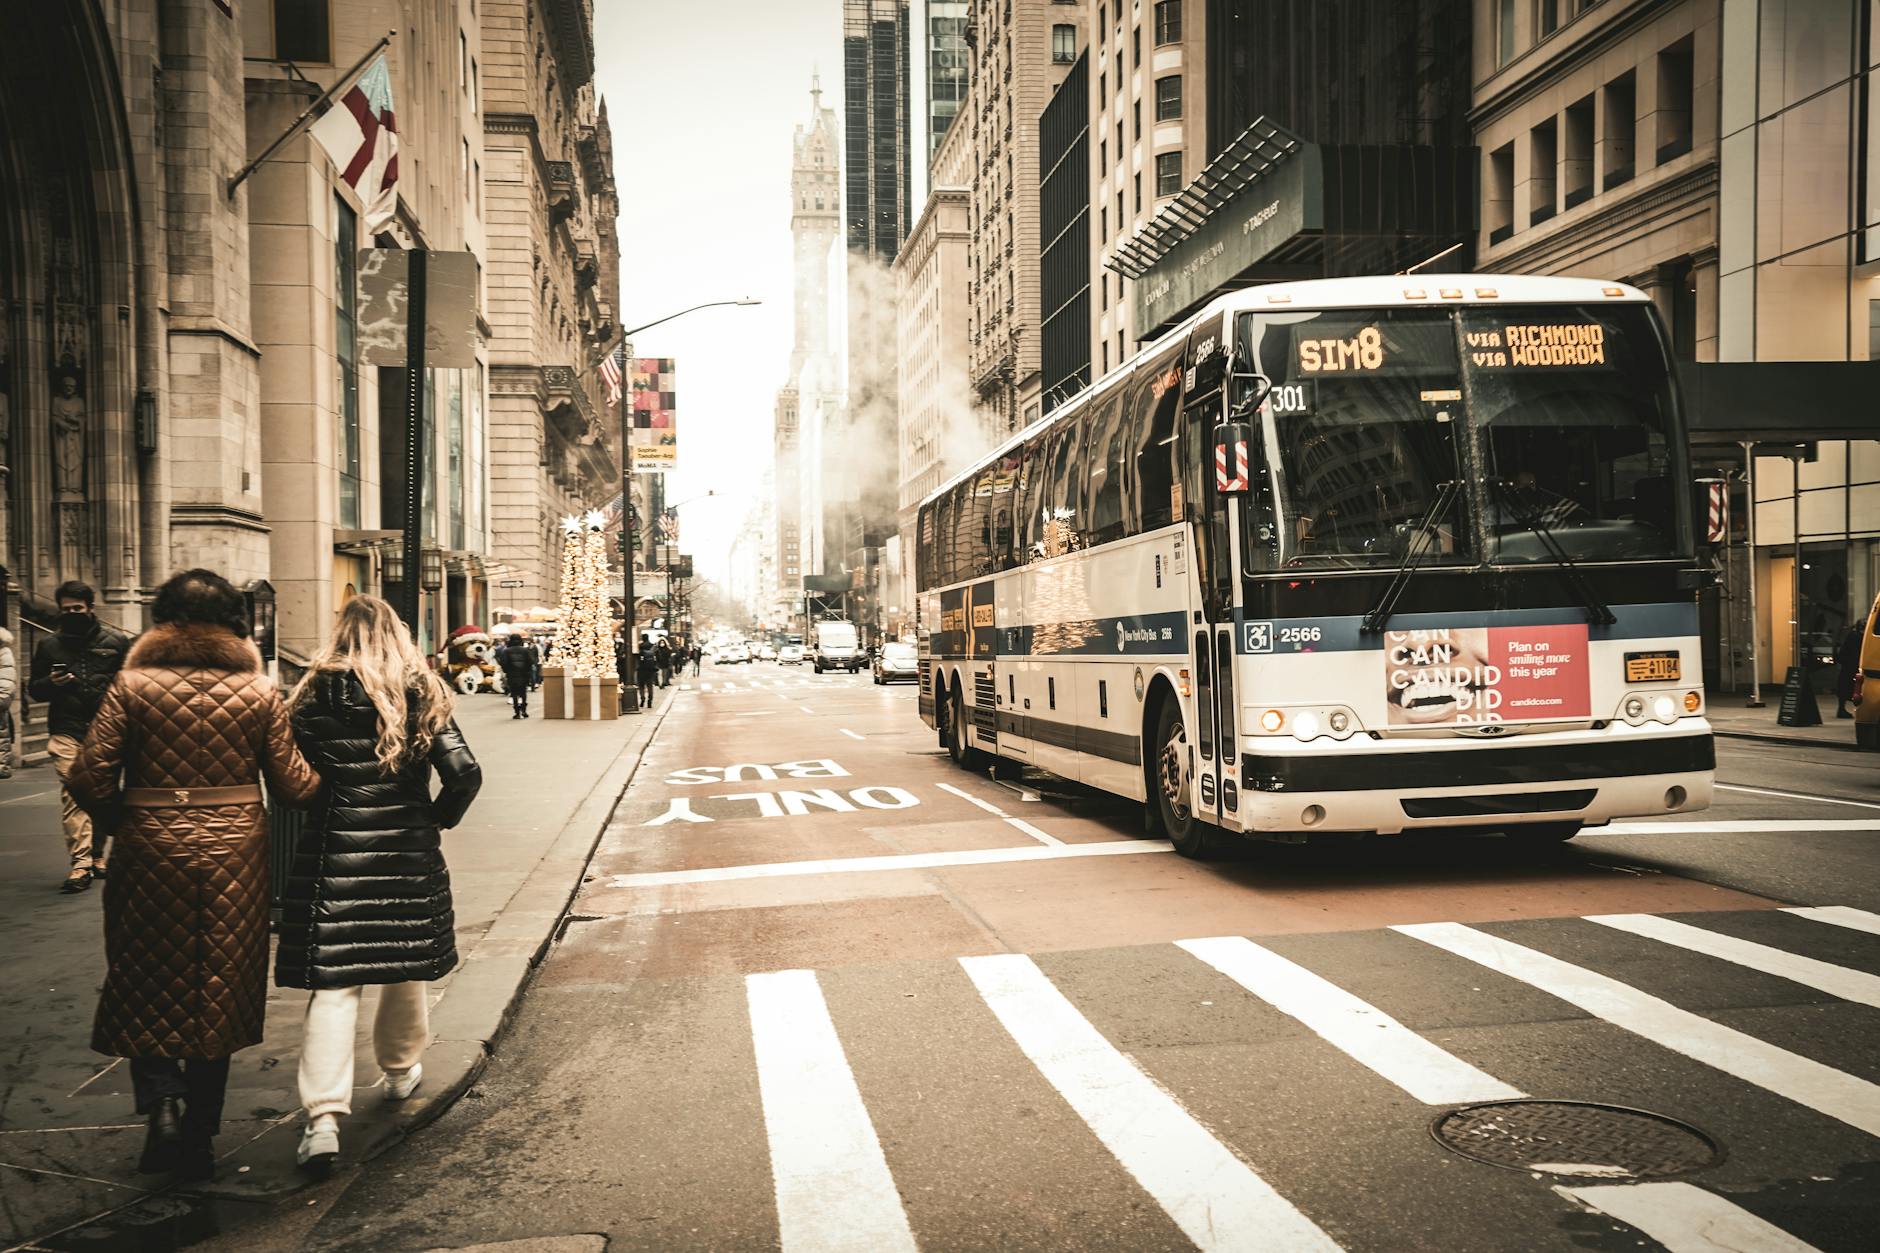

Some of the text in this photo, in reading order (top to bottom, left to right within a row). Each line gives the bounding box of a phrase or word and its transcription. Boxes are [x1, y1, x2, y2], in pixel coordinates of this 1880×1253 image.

[1467, 324, 1604, 347] VIA RICHMOND
[1196, 336, 1215, 365] 2566
[1299, 326, 1383, 372] SIM8
[1472, 344, 1605, 367] VIA WOODROW
[1271, 386, 1306, 412] 301
[1280, 627, 1321, 643] 2566
[1390, 643, 1450, 666] CAN
[1508, 641, 1550, 653] Plan on
[1508, 653, 1571, 666] smiling more
[1390, 665, 1502, 694] CANDID
[1509, 666, 1559, 680] this year
[1456, 688, 1503, 711] DID
[1510, 698, 1563, 707] candidco.com
[664, 758, 853, 785] BUS
[640, 786, 922, 827] ONLY
